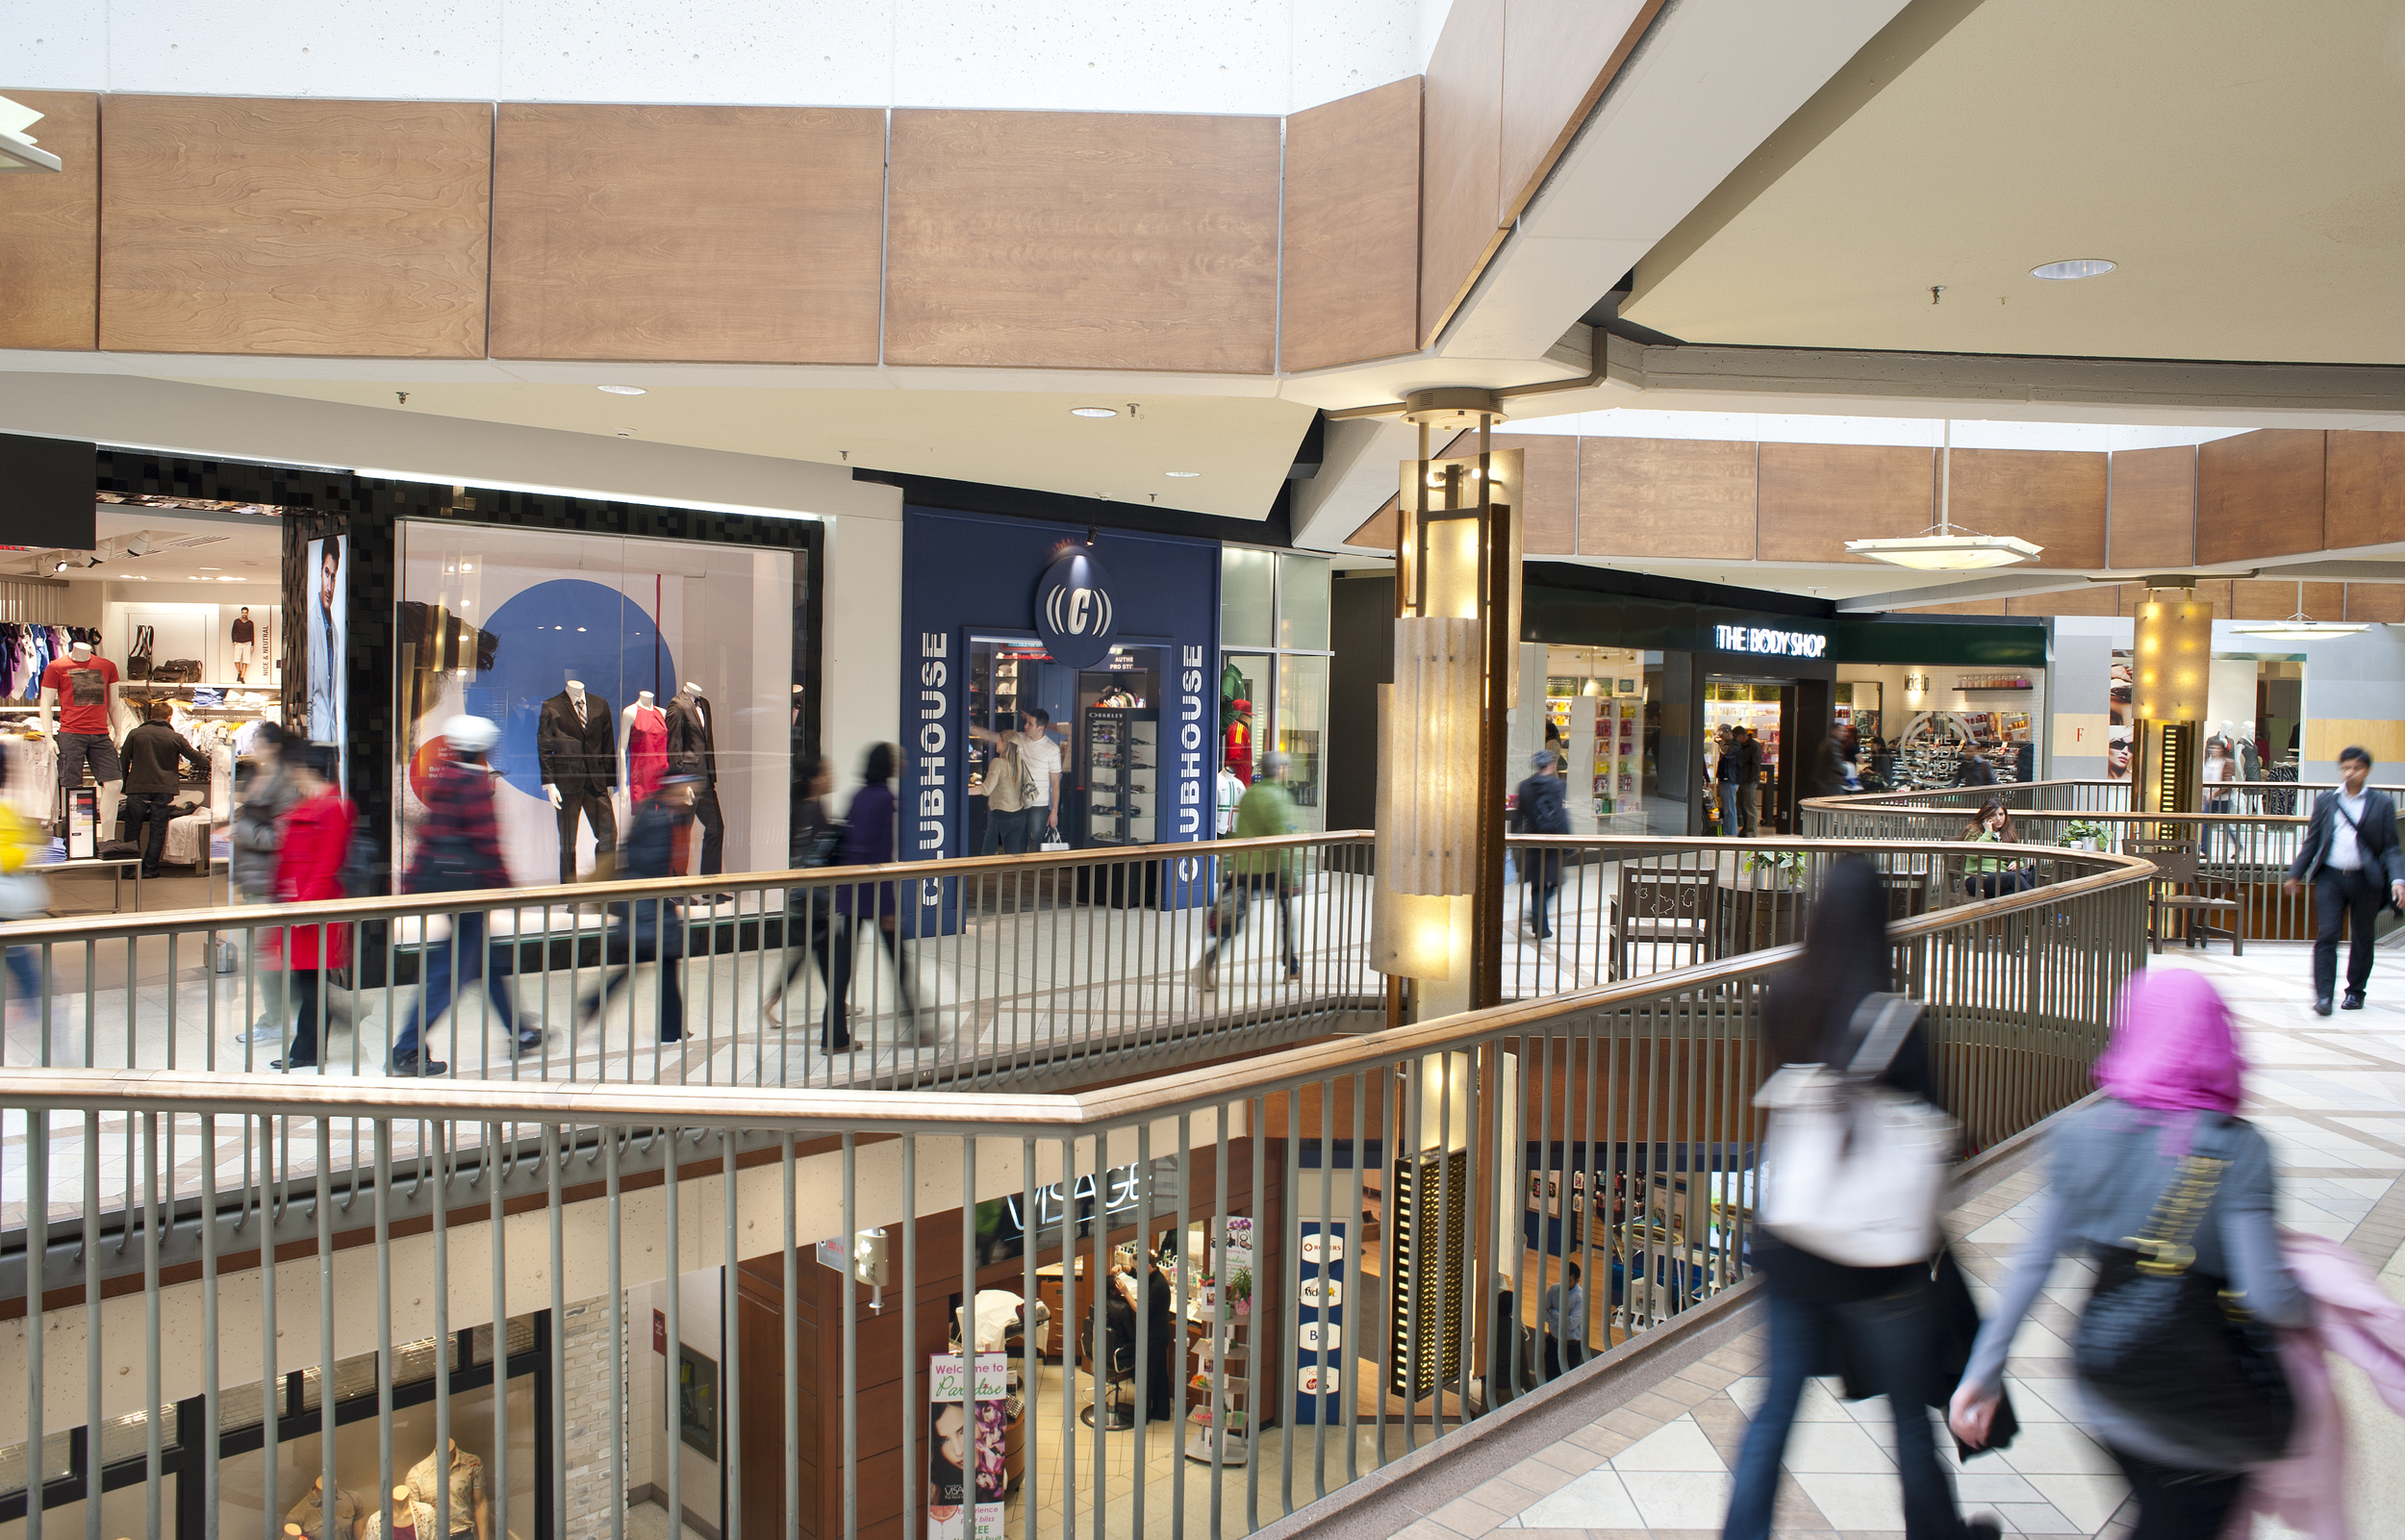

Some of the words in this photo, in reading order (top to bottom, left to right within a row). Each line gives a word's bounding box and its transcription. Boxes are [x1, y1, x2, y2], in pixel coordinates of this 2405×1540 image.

[1716, 624, 1747, 651] THE
[1750, 628, 1790, 655] BODY
[1790, 632, 1827, 658] SHOP
[1926, 733, 1952, 745] THE
[2076, 727, 2085, 743] F
[1916, 745, 1960, 758] BODY
[936, 1364, 989, 1374] Welcme
[994, 1363, 1003, 1373] to
[936, 1376, 1003, 1398] Pardise
